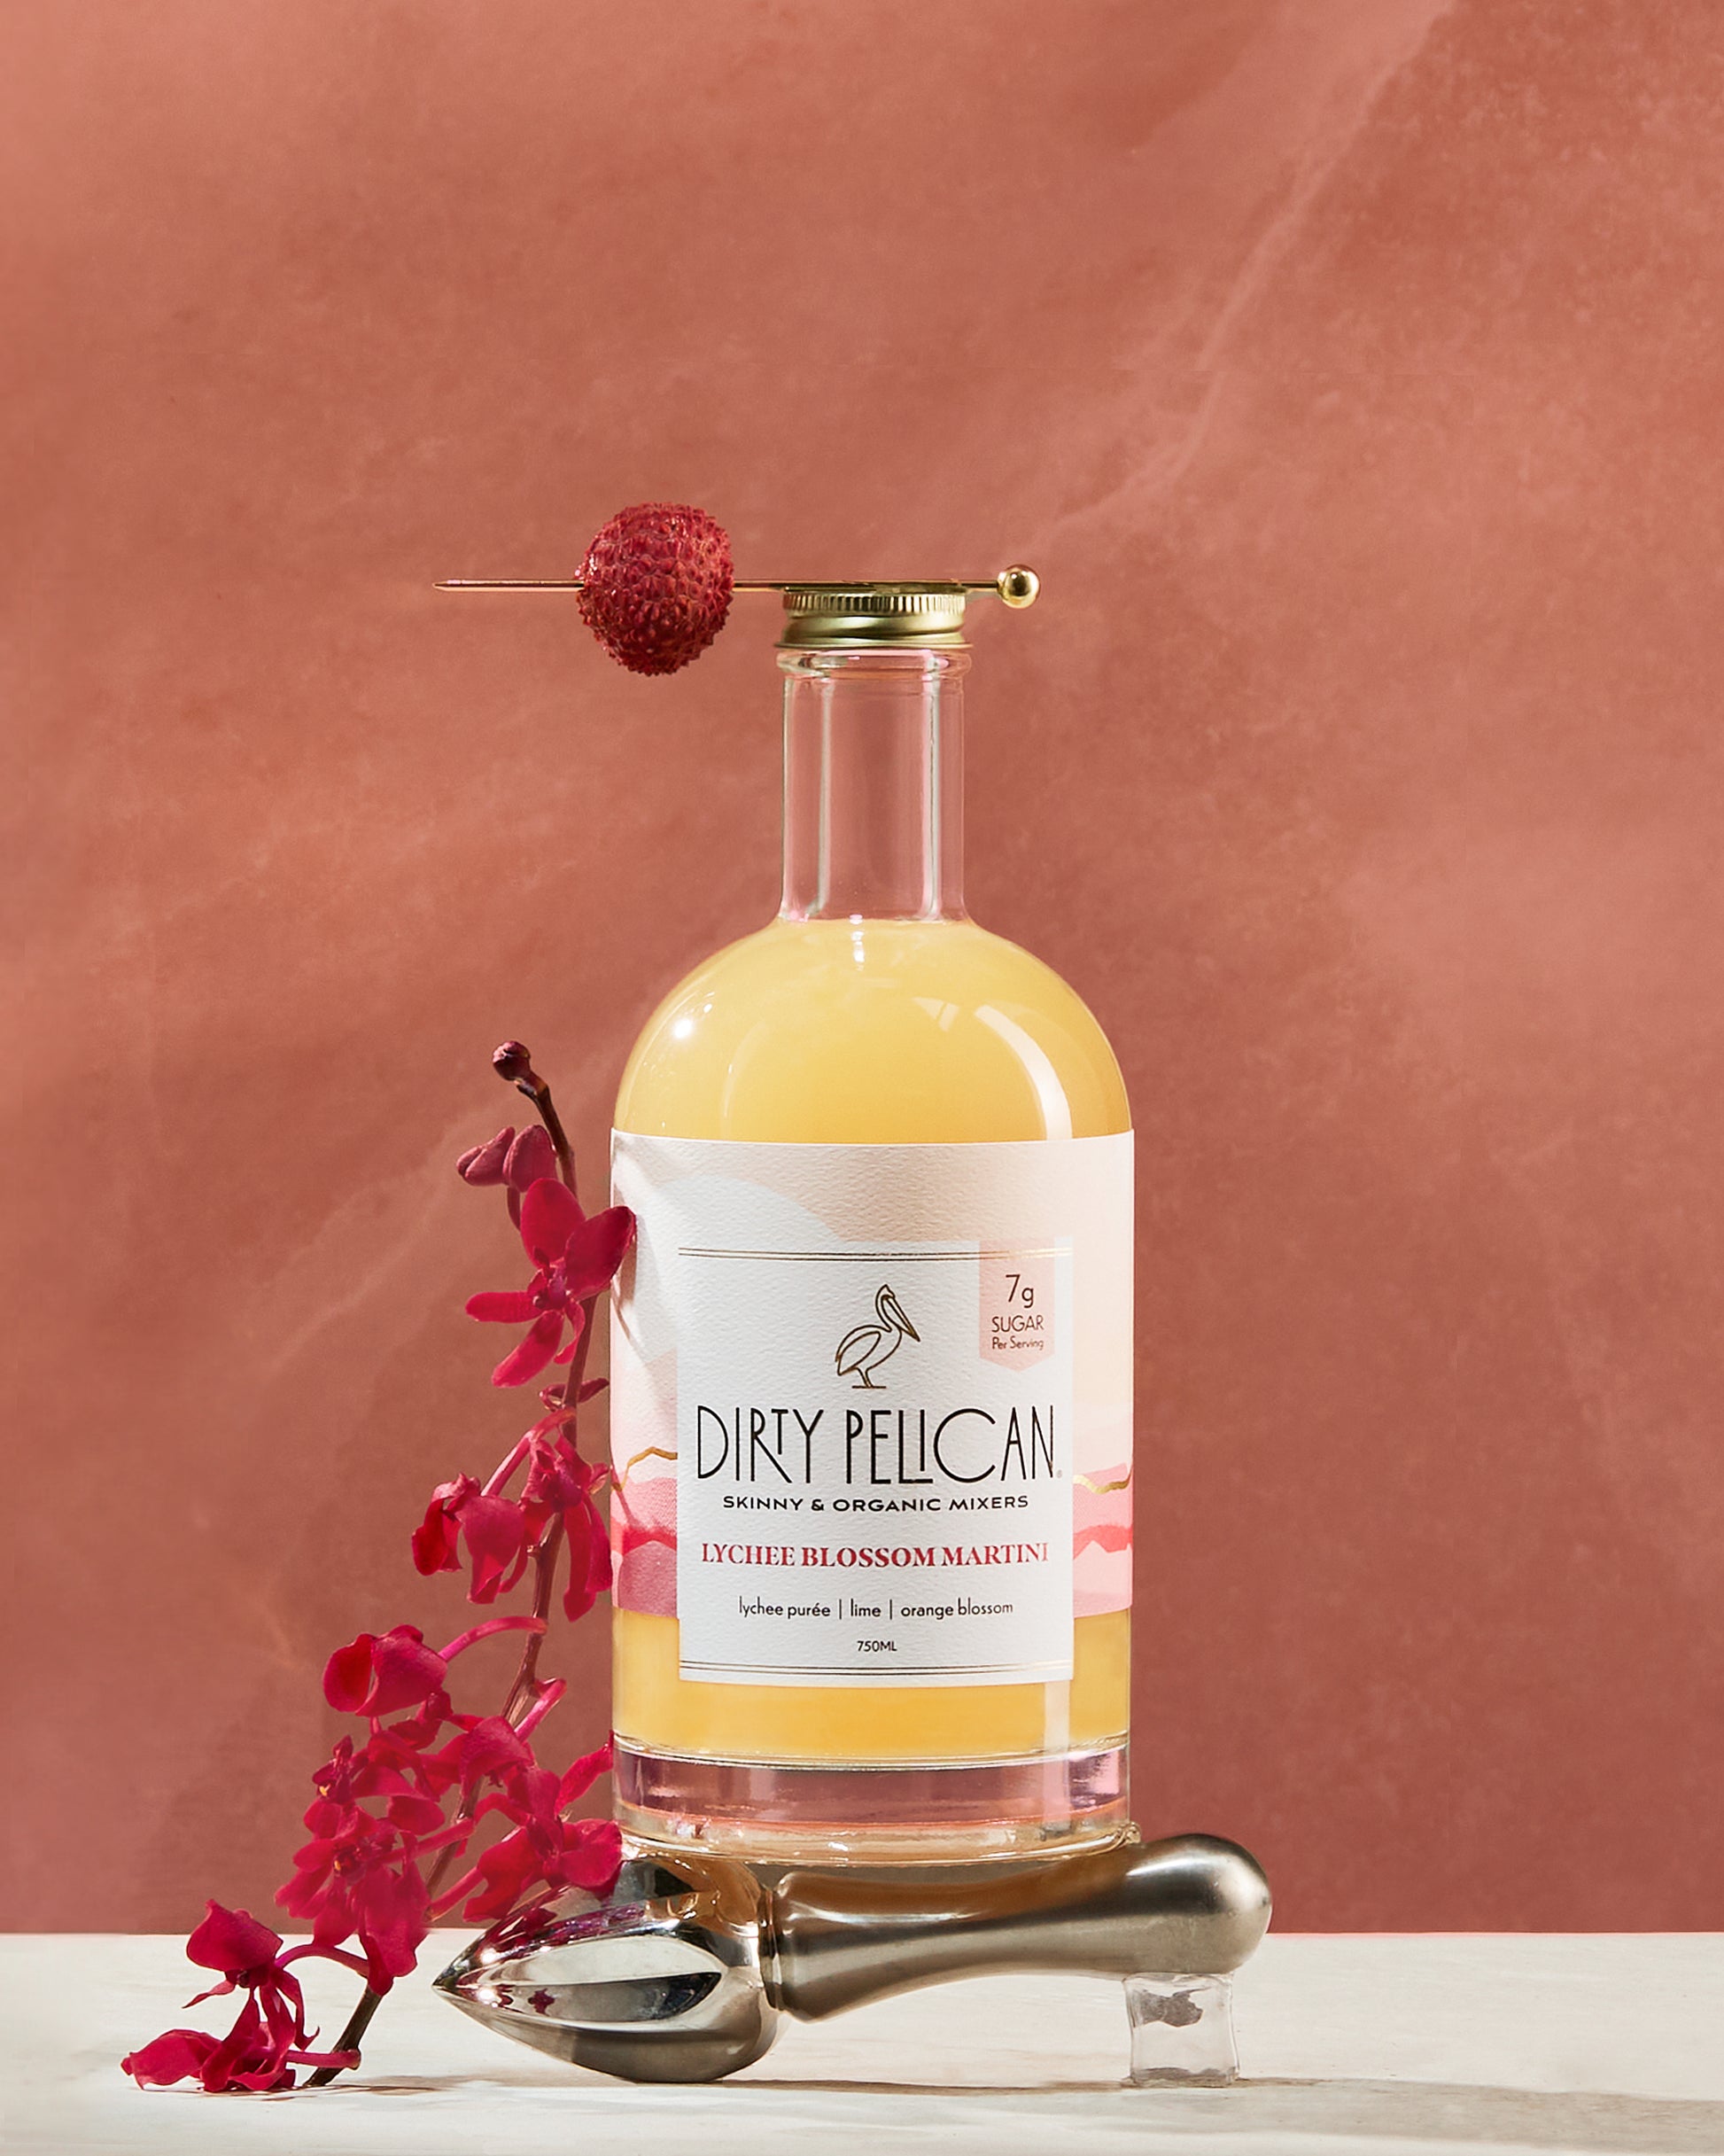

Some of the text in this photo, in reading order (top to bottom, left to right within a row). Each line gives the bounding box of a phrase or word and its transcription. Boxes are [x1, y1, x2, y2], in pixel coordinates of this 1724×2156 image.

[1005, 1273, 1035, 1309] 7g
[991, 1314, 1044, 1333] SUGAR
[991, 1335, 1044, 1351] Per Serving
[697, 1405, 1054, 1485] DIRTY PELICAN
[723, 1495, 1029, 1513] SKINNY & ORGANIC MIXERS
[702, 1543, 1049, 1568] LYCHEE BLOSSOM MARTINI
[738, 1595, 784, 1619] lychee
[787, 1602, 831, 1620] purée
[850, 1598, 881, 1618] lime
[900, 1606, 954, 1621] orange
[957, 1597, 1013, 1616] blossom
[857, 1639, 897, 1653] 750ML
